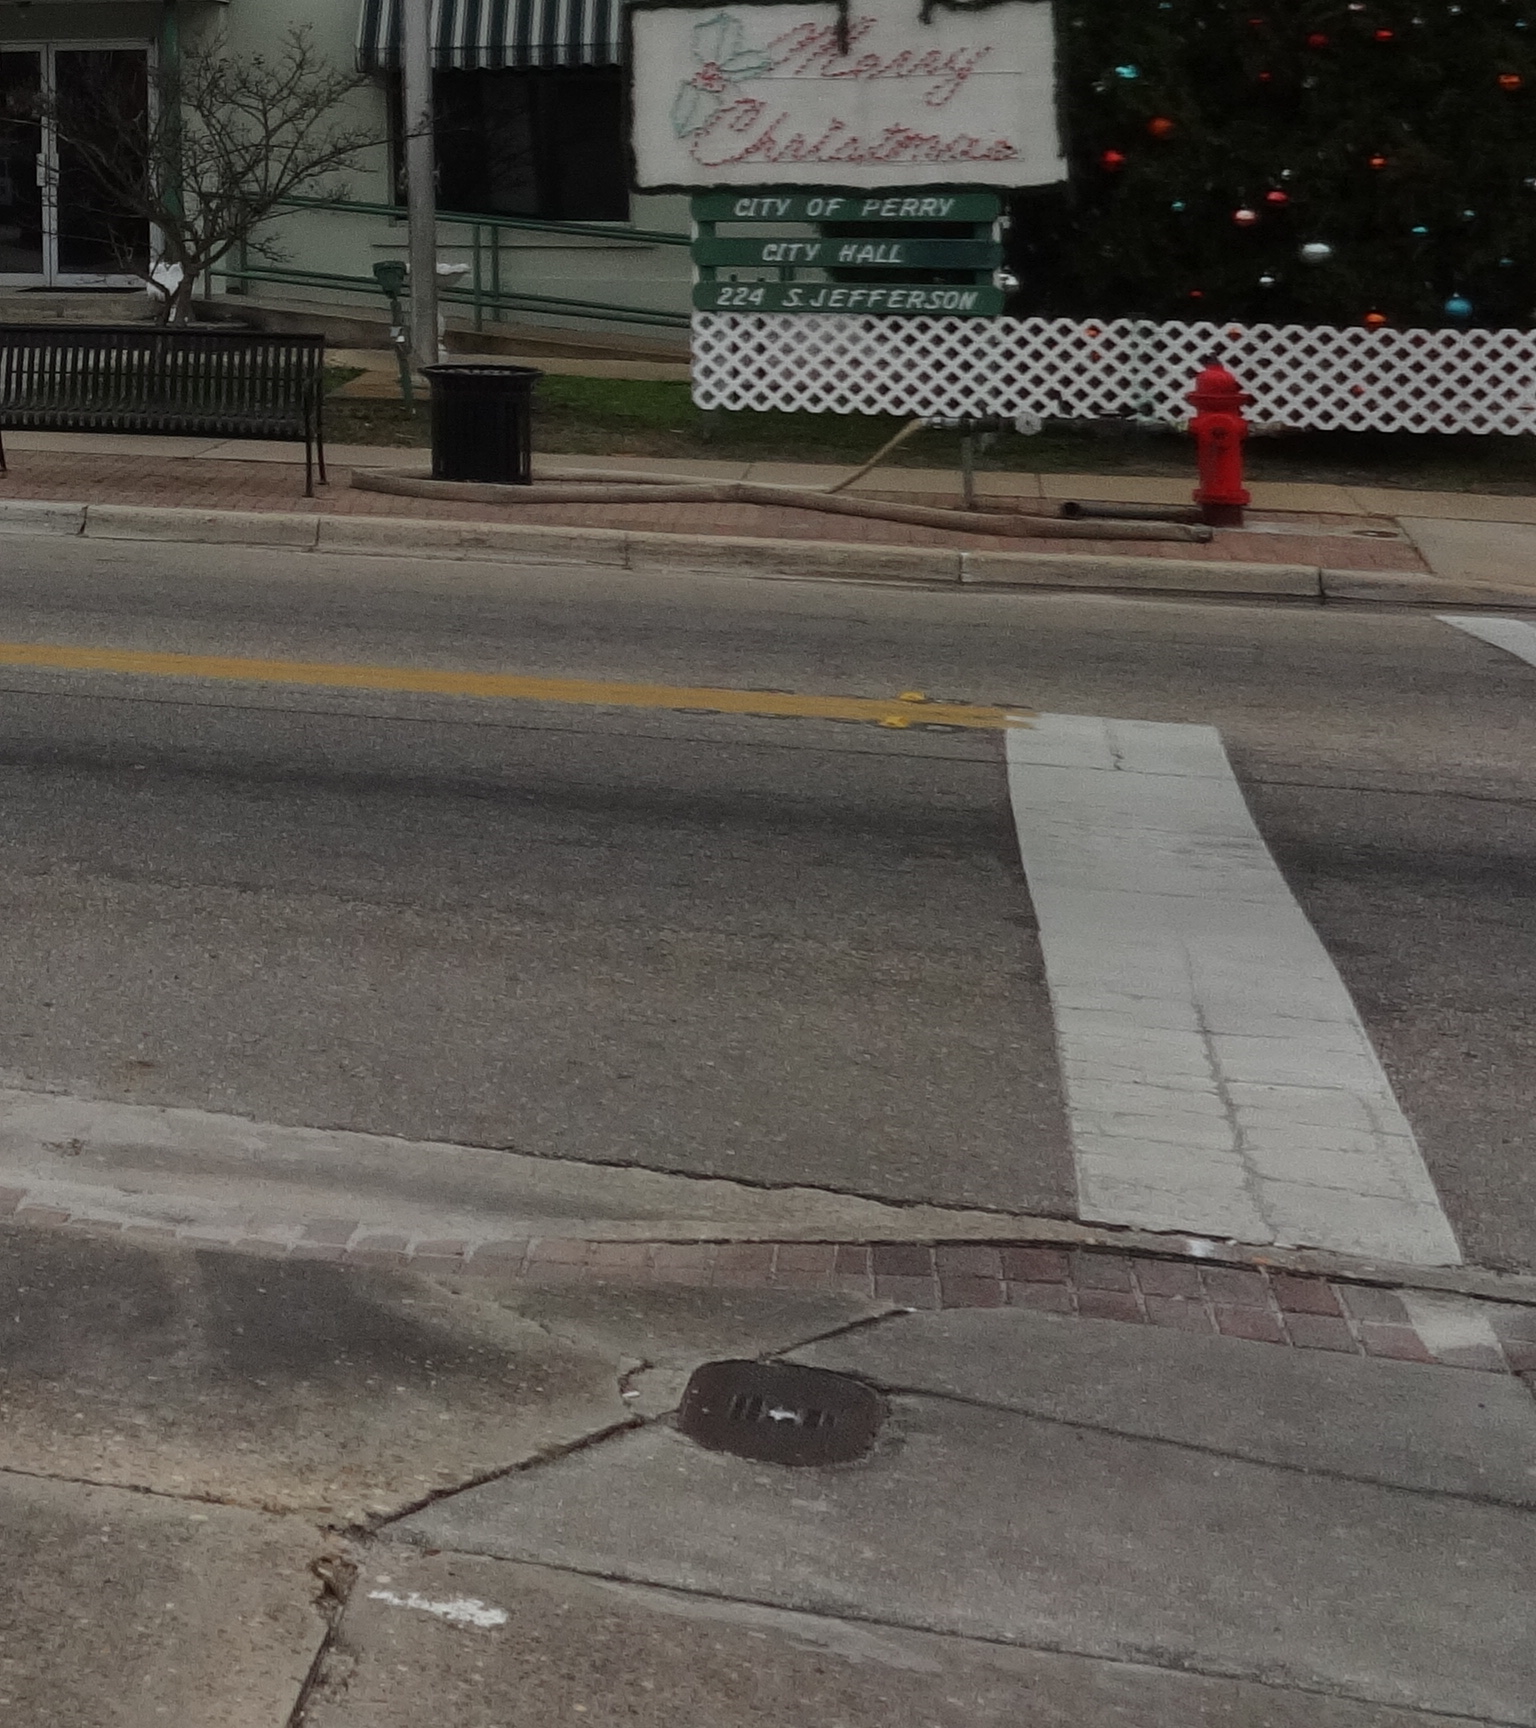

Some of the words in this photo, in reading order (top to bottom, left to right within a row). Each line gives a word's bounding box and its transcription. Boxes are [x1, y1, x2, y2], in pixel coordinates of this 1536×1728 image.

[734, 198, 792, 217] CITY
[806, 198, 846, 217] OF
[861, 198, 955, 217] PERRY
[762, 243, 822, 262] CITY
[838, 244, 906, 263] HALL
[716, 287, 766, 306] 224
[809, 289, 978, 310] JEFFERSON
